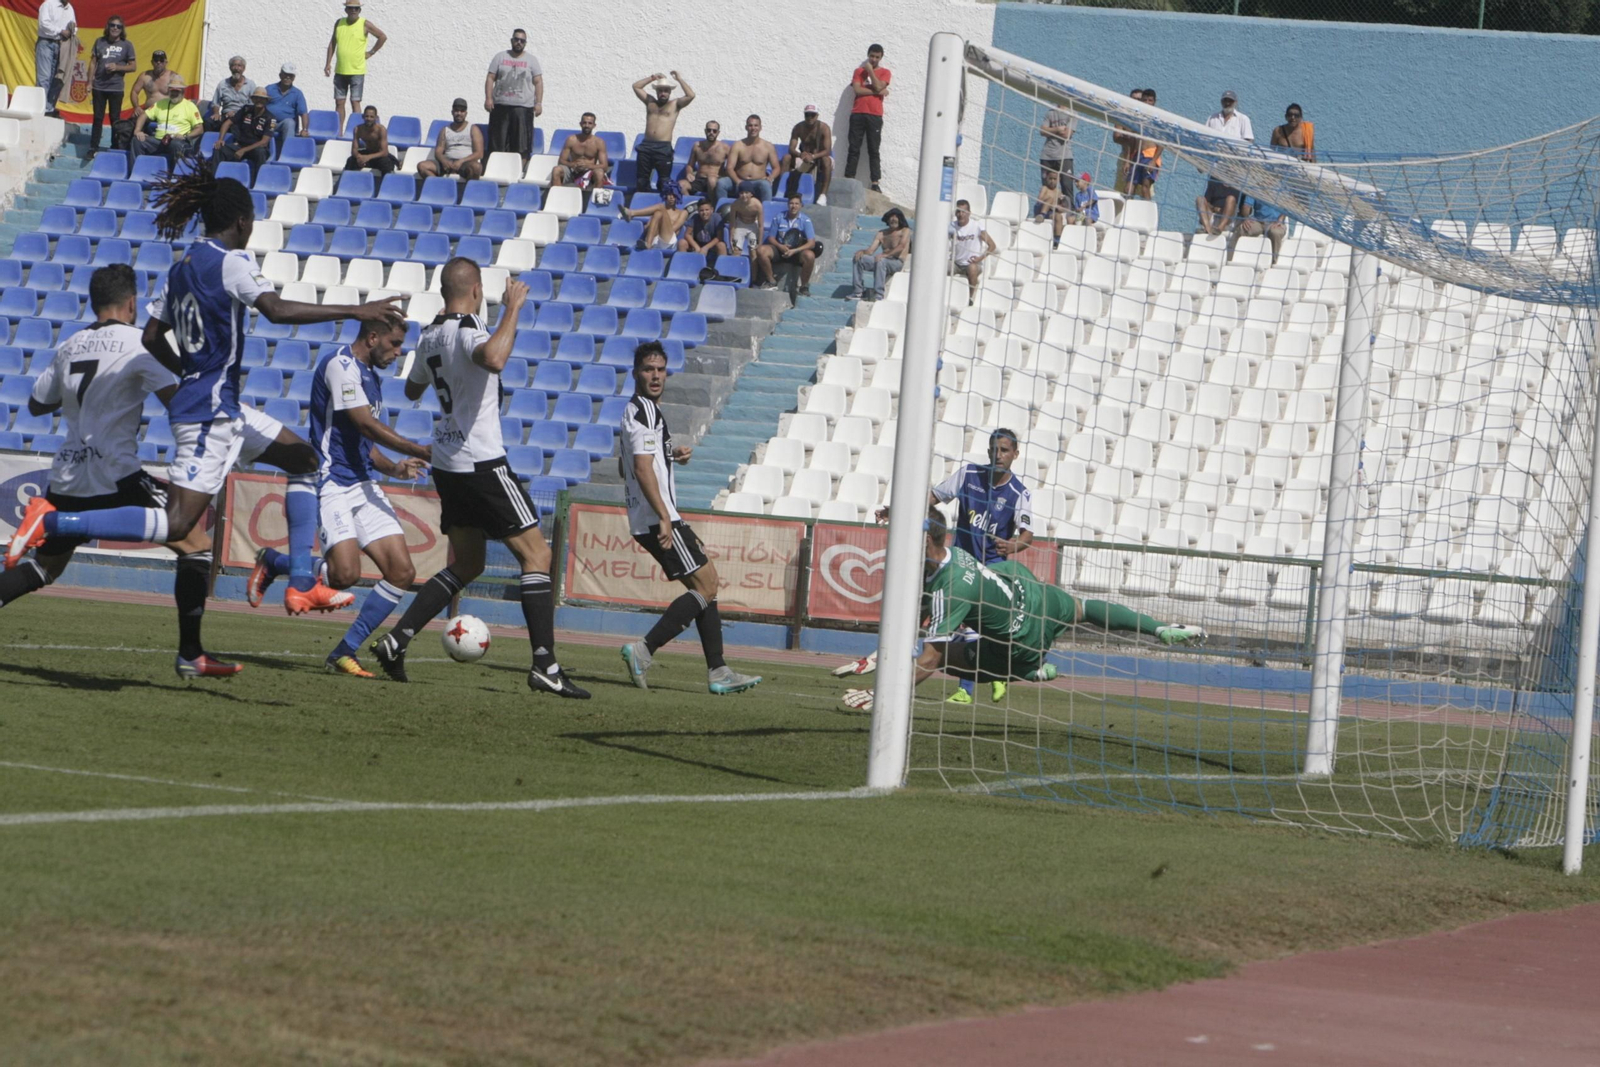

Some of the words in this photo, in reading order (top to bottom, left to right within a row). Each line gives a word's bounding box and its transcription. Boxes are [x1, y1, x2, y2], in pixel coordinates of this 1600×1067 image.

[172, 291, 205, 353] 10
[69, 359, 100, 410] 7
[426, 354, 453, 415] 5
[582, 532, 791, 564] INMSTIÓN
[740, 572, 785, 591] SL
